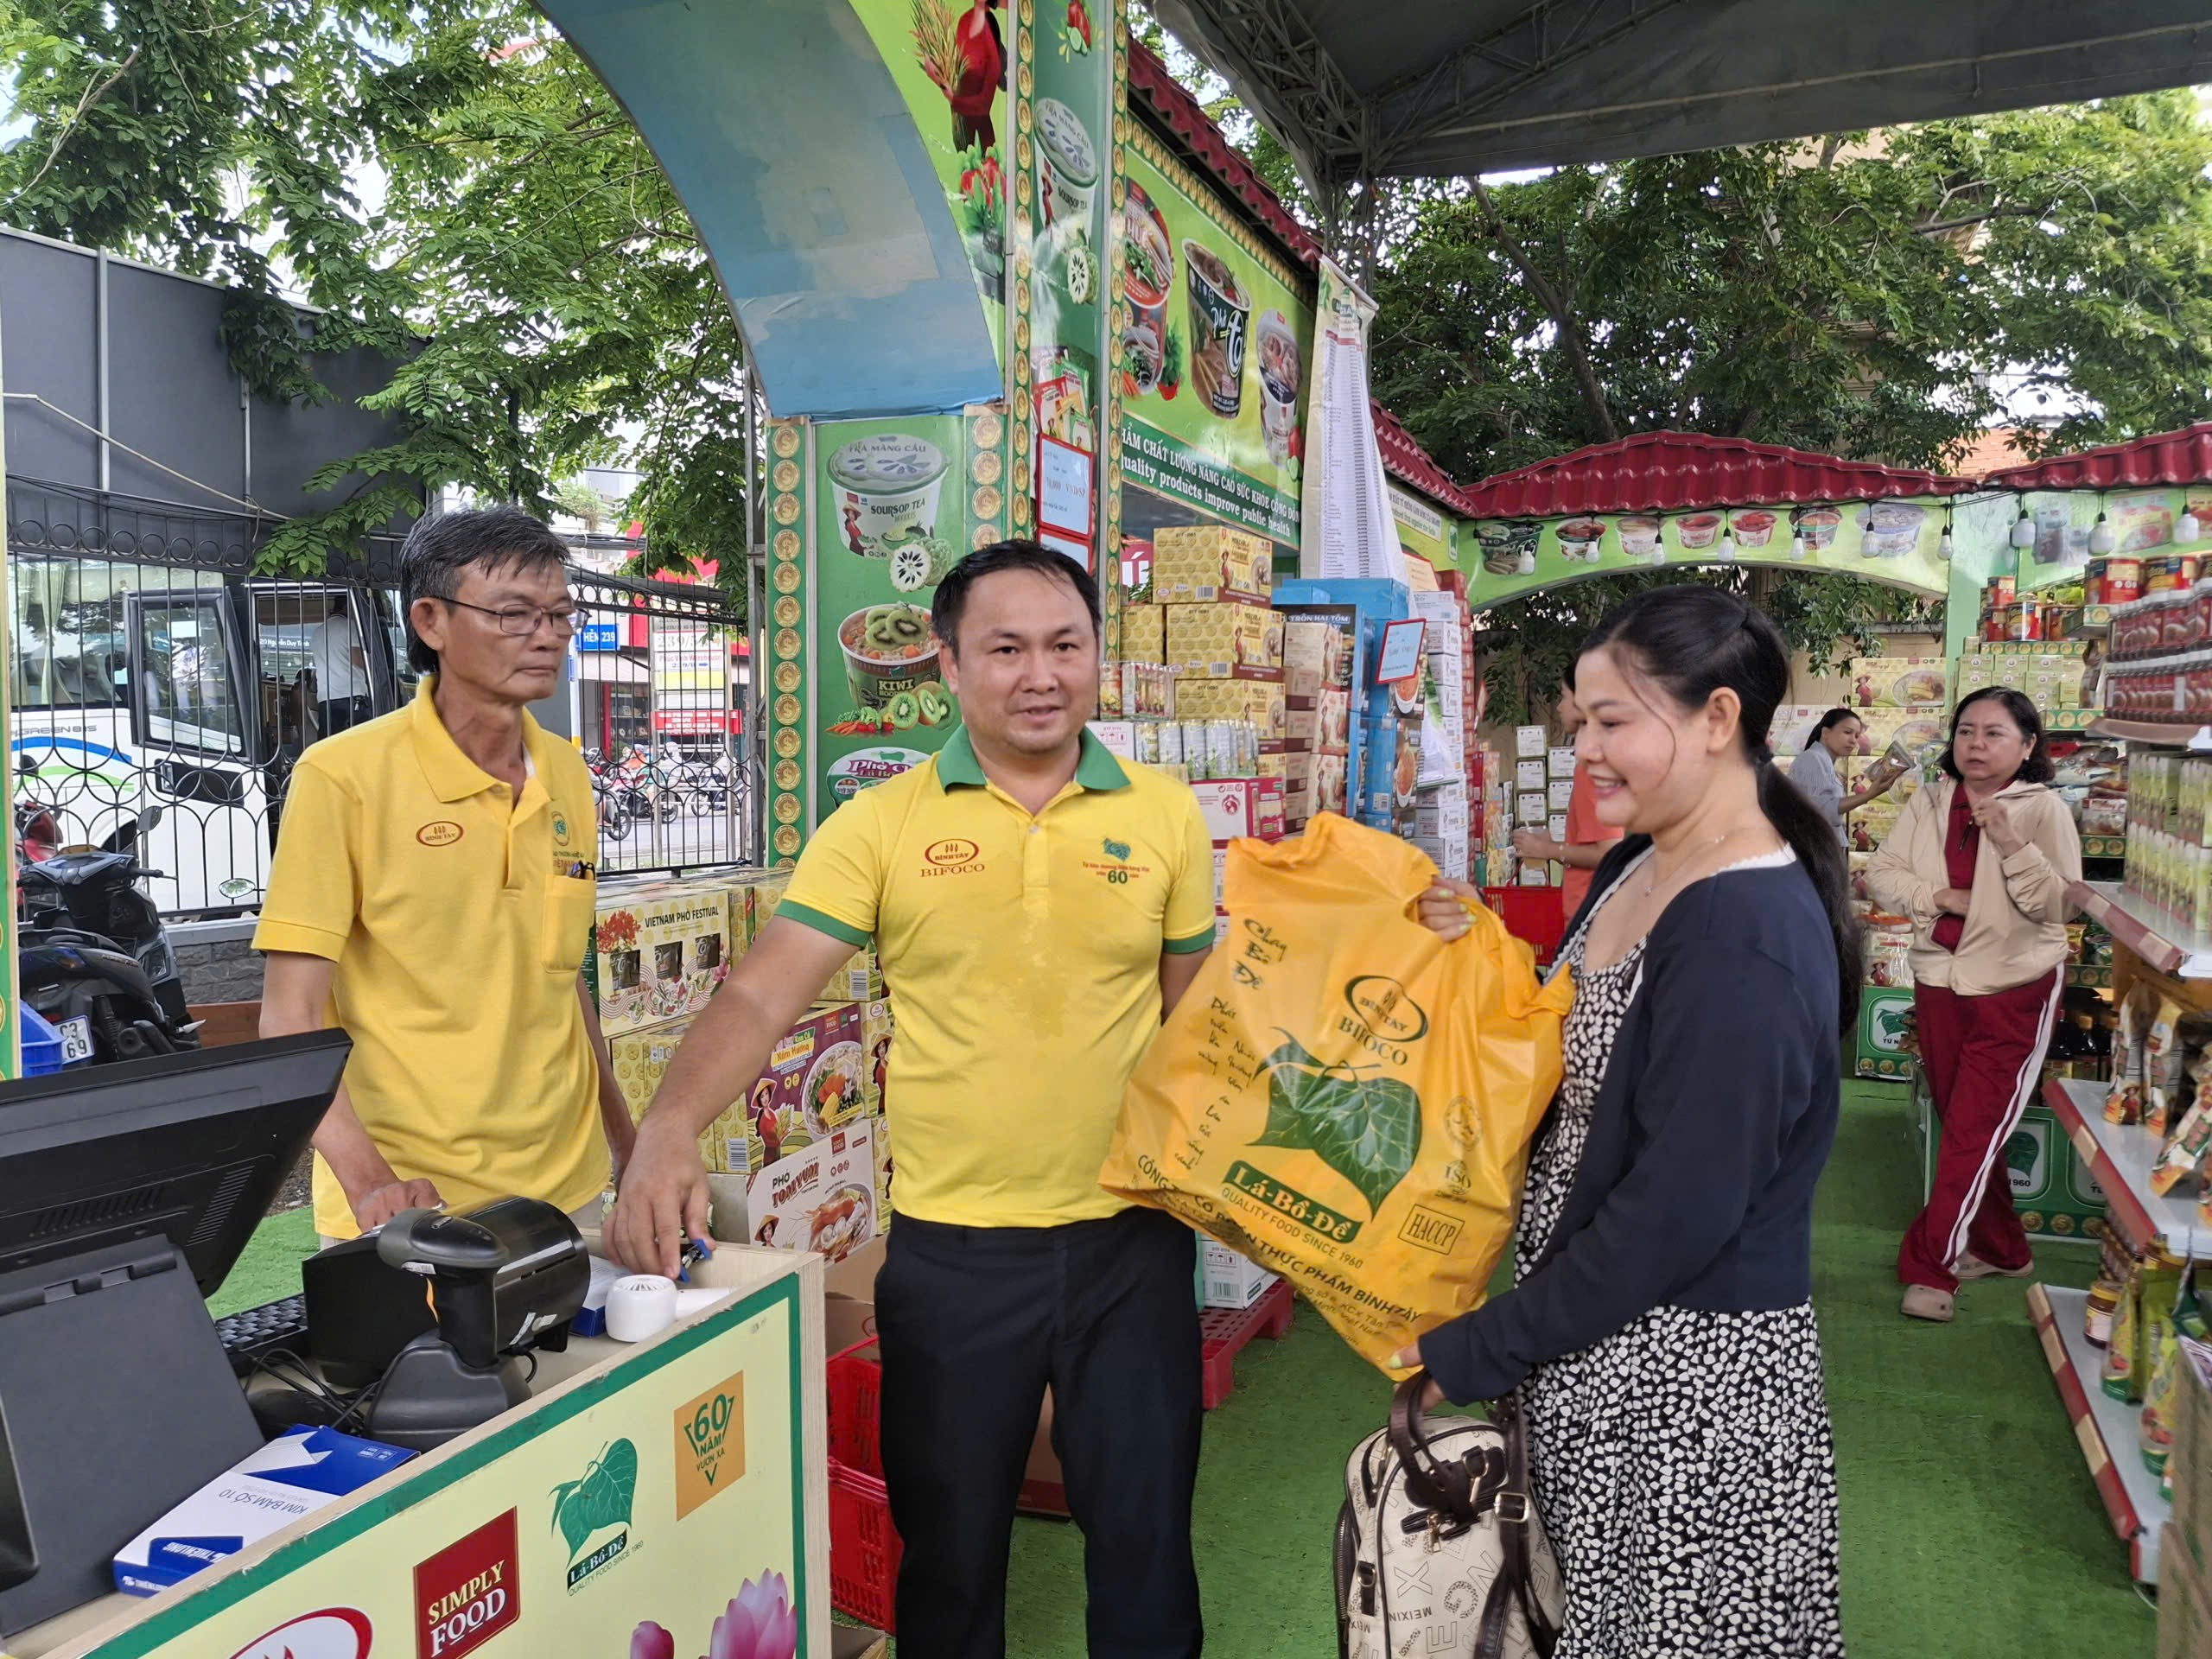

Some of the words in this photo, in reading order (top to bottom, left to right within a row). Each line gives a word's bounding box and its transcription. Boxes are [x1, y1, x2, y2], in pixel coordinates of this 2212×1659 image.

[1143, 438, 1168, 462] CHẤT
[1170, 450, 1197, 476] LƯỢNG
[1220, 474, 1236, 493] CAO
[870, 502, 910, 518] SOURSOP
[912, 497, 926, 509] TEA
[1159, 469, 1203, 500] products
[1205, 487, 1240, 516] improve
[1242, 505, 1267, 527] public
[1268, 514, 1291, 538] health
[601, 632, 616, 643] 239
[877, 679, 914, 691] KIWI
[851, 760, 888, 772] Phở
[920, 864, 986, 877] BIFOCO
[1107, 869, 1128, 884] 60
[645, 913, 675, 928] VIETNAM
[692, 906, 720, 919] FESTIVAL
[1338, 1016, 1408, 1066] BIFOCO
[1445, 1166, 1471, 1190] ISO
[1233, 1166, 1353, 1241] Lá-Bồ-Đề
[1137, 1154, 1169, 1190] CÔNG
[1259, 1240, 1302, 1274] THỰC
[1303, 1265, 1353, 1295] PHẨM
[1221, 1186, 1268, 1219] QUALITY
[1268, 1216, 1301, 1238] FOOD
[1301, 1232, 1338, 1258] SINCE
[1339, 1251, 1364, 1270] 1960
[1406, 1212, 1458, 1248] HACCP
[694, 1393, 728, 1442] 60
[700, 1433, 722, 1458] NĂM
[716, 1446, 726, 1459] XA
[218, 1488, 237, 1499] 10
[230, 1491, 257, 1506] SỐ
[251, 1496, 285, 1511] BẤM
[280, 1502, 309, 1515] KIM
[569, 1574, 594, 1598] QUALITY
[595, 1562, 612, 1577] FOOD
[613, 1548, 631, 1567] SINCE
[429, 1560, 505, 1625] SIMPLY
[430, 1588, 506, 1658] FOOD
[1389, 1605, 1433, 1624] MEIXIN
